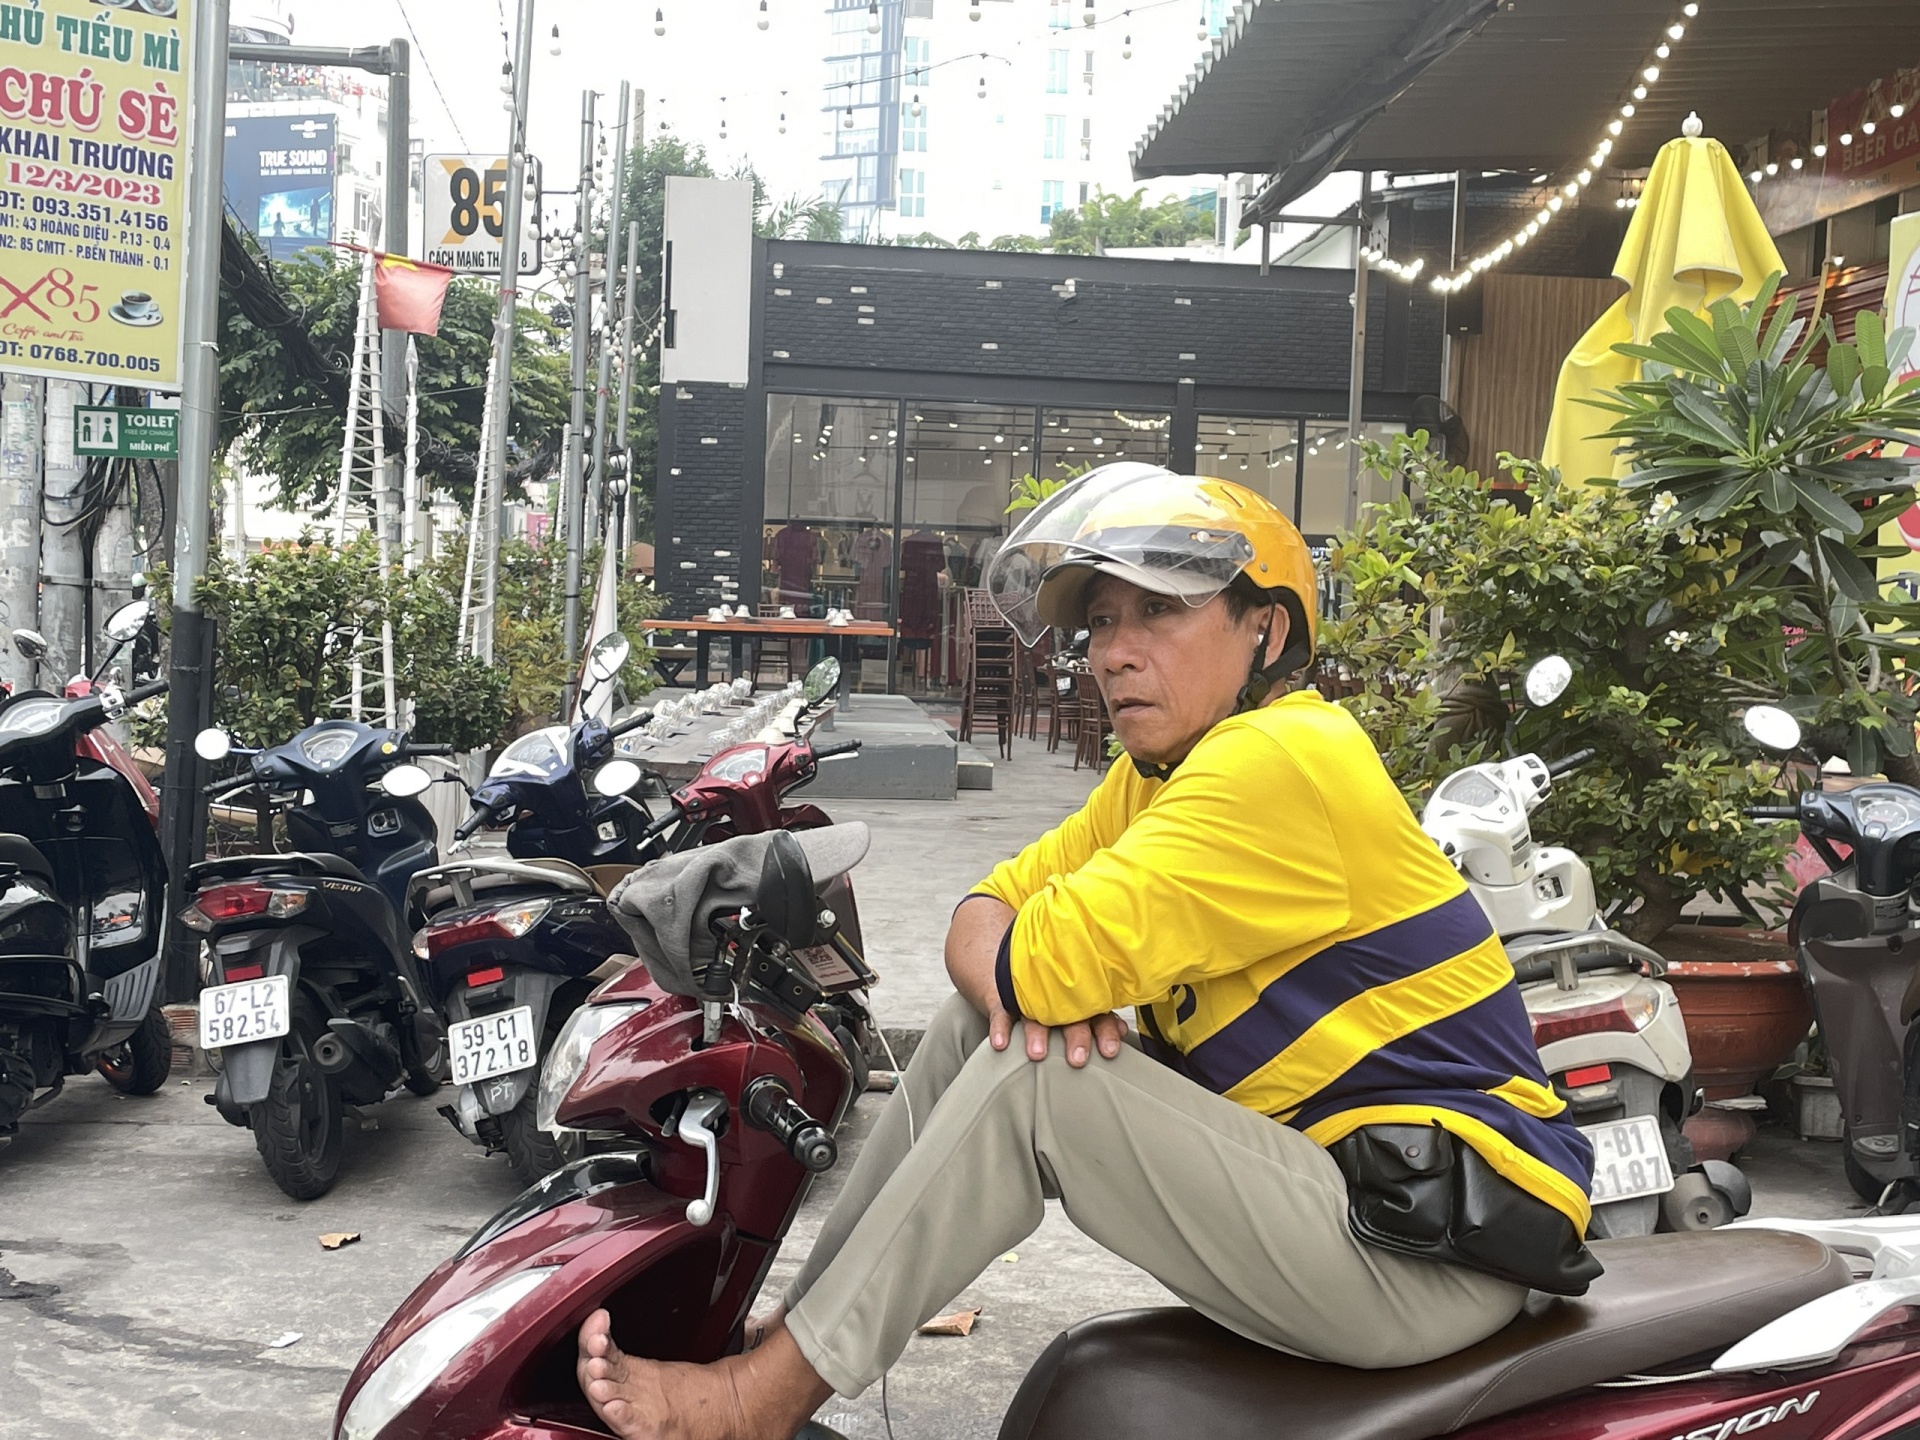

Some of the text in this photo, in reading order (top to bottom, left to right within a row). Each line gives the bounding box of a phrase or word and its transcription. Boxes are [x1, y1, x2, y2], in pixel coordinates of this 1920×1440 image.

[56, 11, 132, 62] TIẾU
[143, 29, 179, 72] MÌ
[0, 68, 177, 144] CHÚ SÈ
[0, 126, 174, 180] KHAI TRƯƠNG
[259, 149, 327, 167] TRUE SOUND
[9, 162, 161, 205] 12/3/2023
[32, 196, 168, 231] 093.351.4156
[450, 168, 508, 237] 85
[23, 217, 37, 231] 43
[40, 218, 79, 237] HOÀNG
[120, 231, 142, 246] P.13
[153, 236, 171, 251] Q.4
[20, 237, 33, 251] 85
[36, 239, 66, 255] CMTT
[109, 248, 143, 267] THÀNH
[153, 257, 169, 270] Q.1
[429, 246, 454, 267] CÁCH
[457, 250, 485, 269] MẠNG
[521, 252, 528, 267] 8
[43, 330, 67, 339] and
[68, 330, 84, 341] Tea
[30, 344, 160, 372] 0768.700.005
[126, 414, 174, 428] TOILET
[215, 983, 275, 1015] 67-L2
[209, 1009, 280, 1042] 582.54
[462, 1015, 517, 1049] 59-C1
[457, 1039, 529, 1078] 372.18
